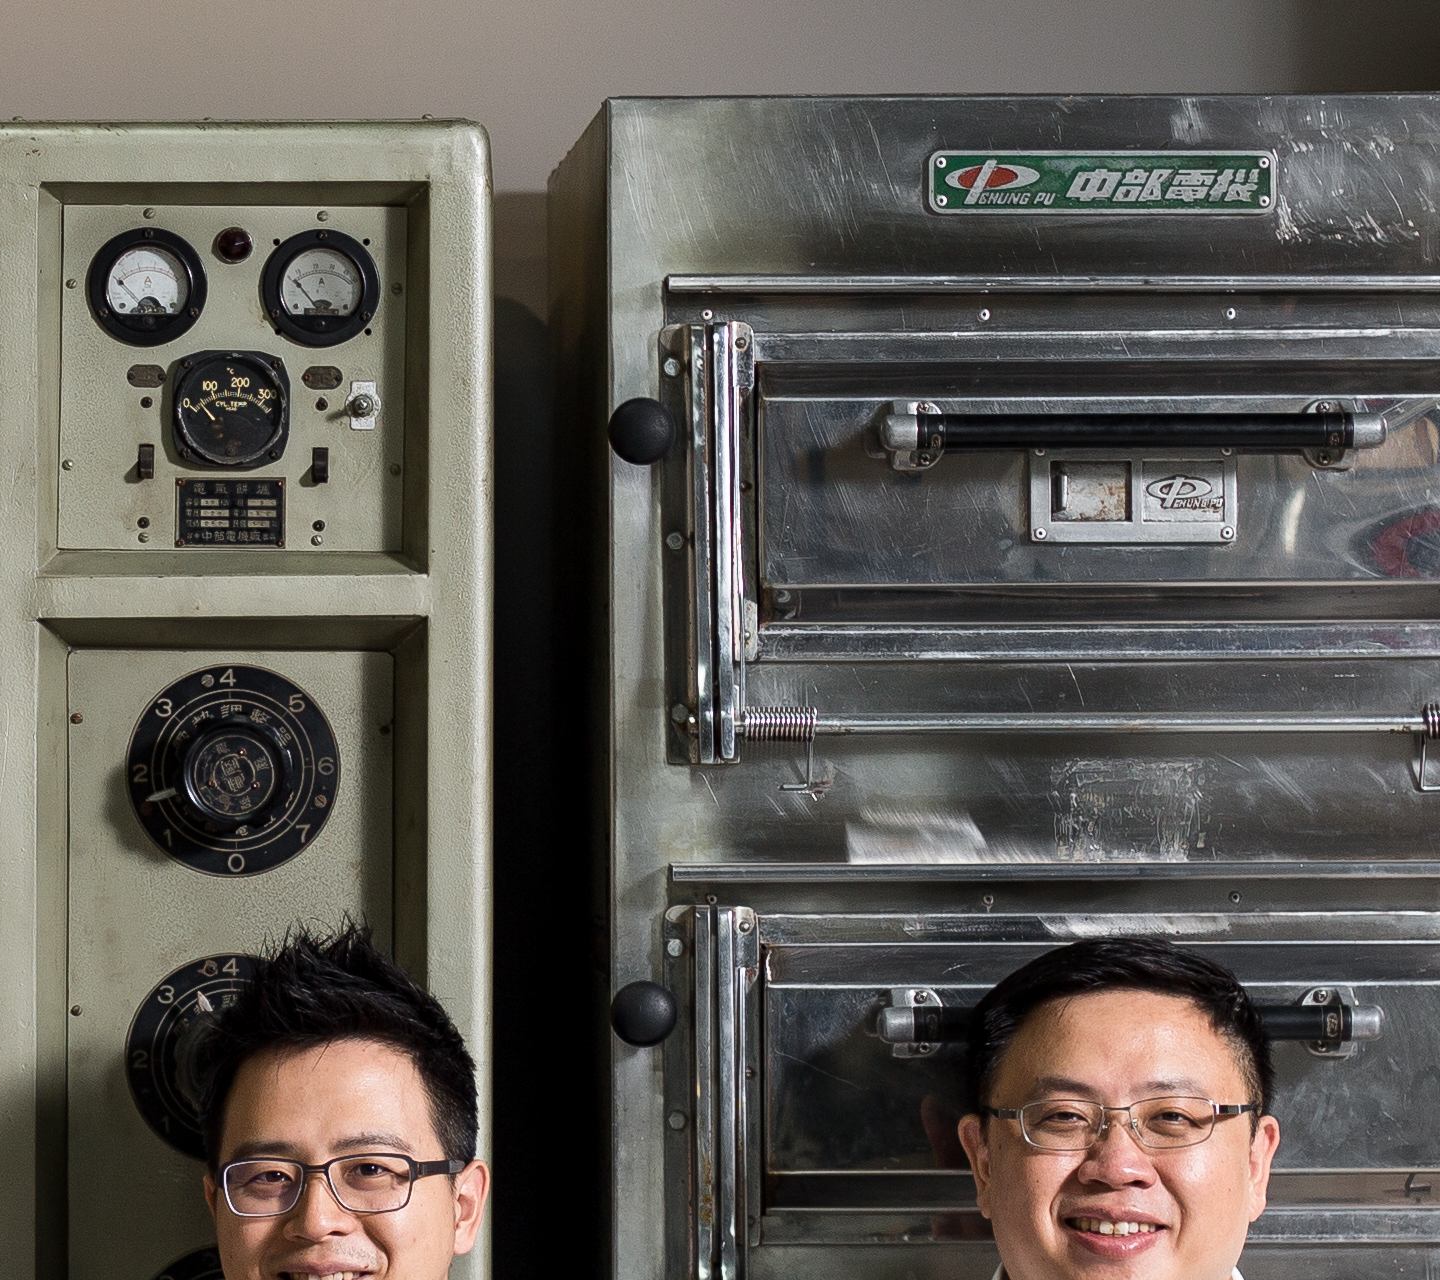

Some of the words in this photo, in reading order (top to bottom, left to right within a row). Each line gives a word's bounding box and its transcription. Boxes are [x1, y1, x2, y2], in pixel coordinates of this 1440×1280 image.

[1065, 168, 1261, 202] 中部電機
[977, 190, 1030, 206] CHUNG
[1034, 191, 1056, 206] PU
[318, 277, 326, 286] A
[202, 380, 218, 391] 100
[231, 377, 250, 388] 200
[183, 398, 191, 408] 0
[258, 388, 277, 399] 300
[219, 668, 237, 687] 4
[155, 698, 173, 717] 3
[289, 694, 306, 713] 5
[133, 764, 148, 782] 2
[318, 757, 335, 776] 6
[295, 824, 311, 844] 7
[227, 853, 245, 872] 0
[223, 957, 240, 977] 4
[157, 985, 175, 1004] 3
[132, 1050, 148, 1069] 2
